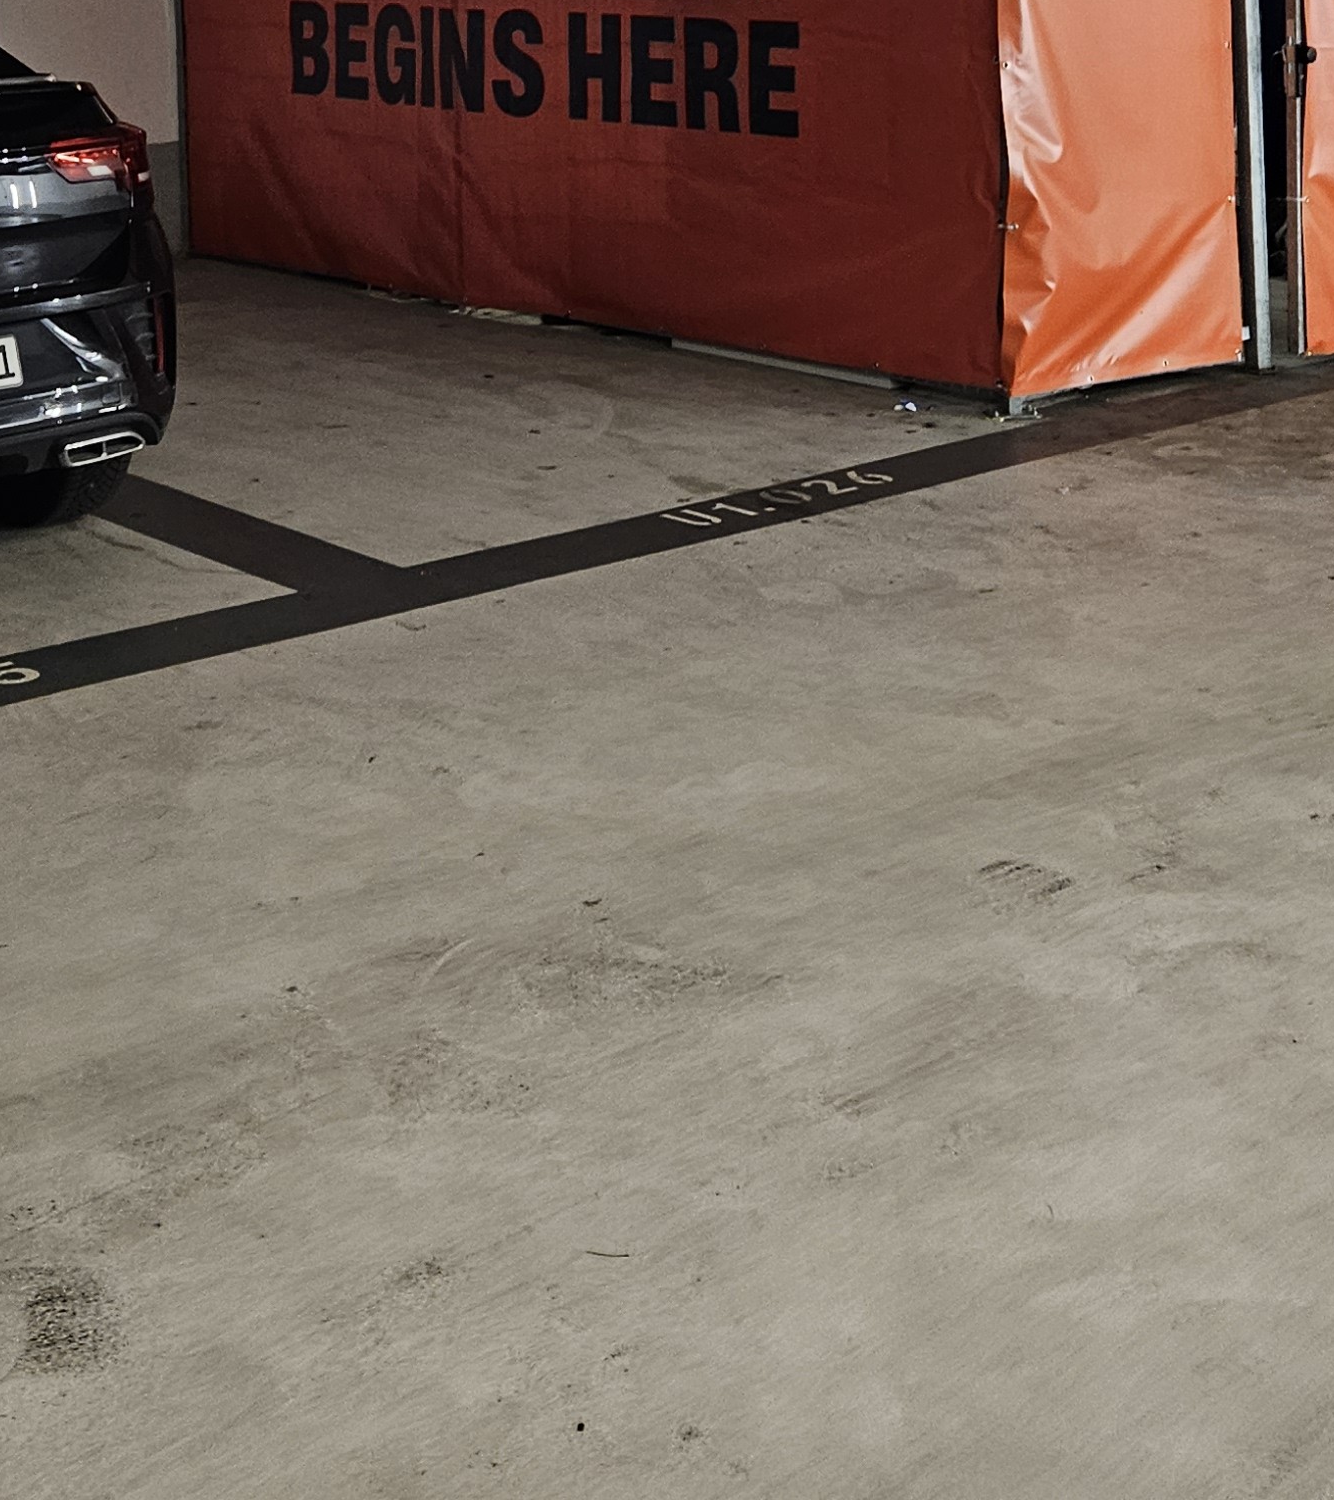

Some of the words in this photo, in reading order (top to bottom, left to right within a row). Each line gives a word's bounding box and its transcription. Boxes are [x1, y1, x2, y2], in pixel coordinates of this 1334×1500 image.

[288, 0, 545, 117] BEGINS
[567, 11, 800, 138] HERE
[660, 470, 894, 526] U1.026
